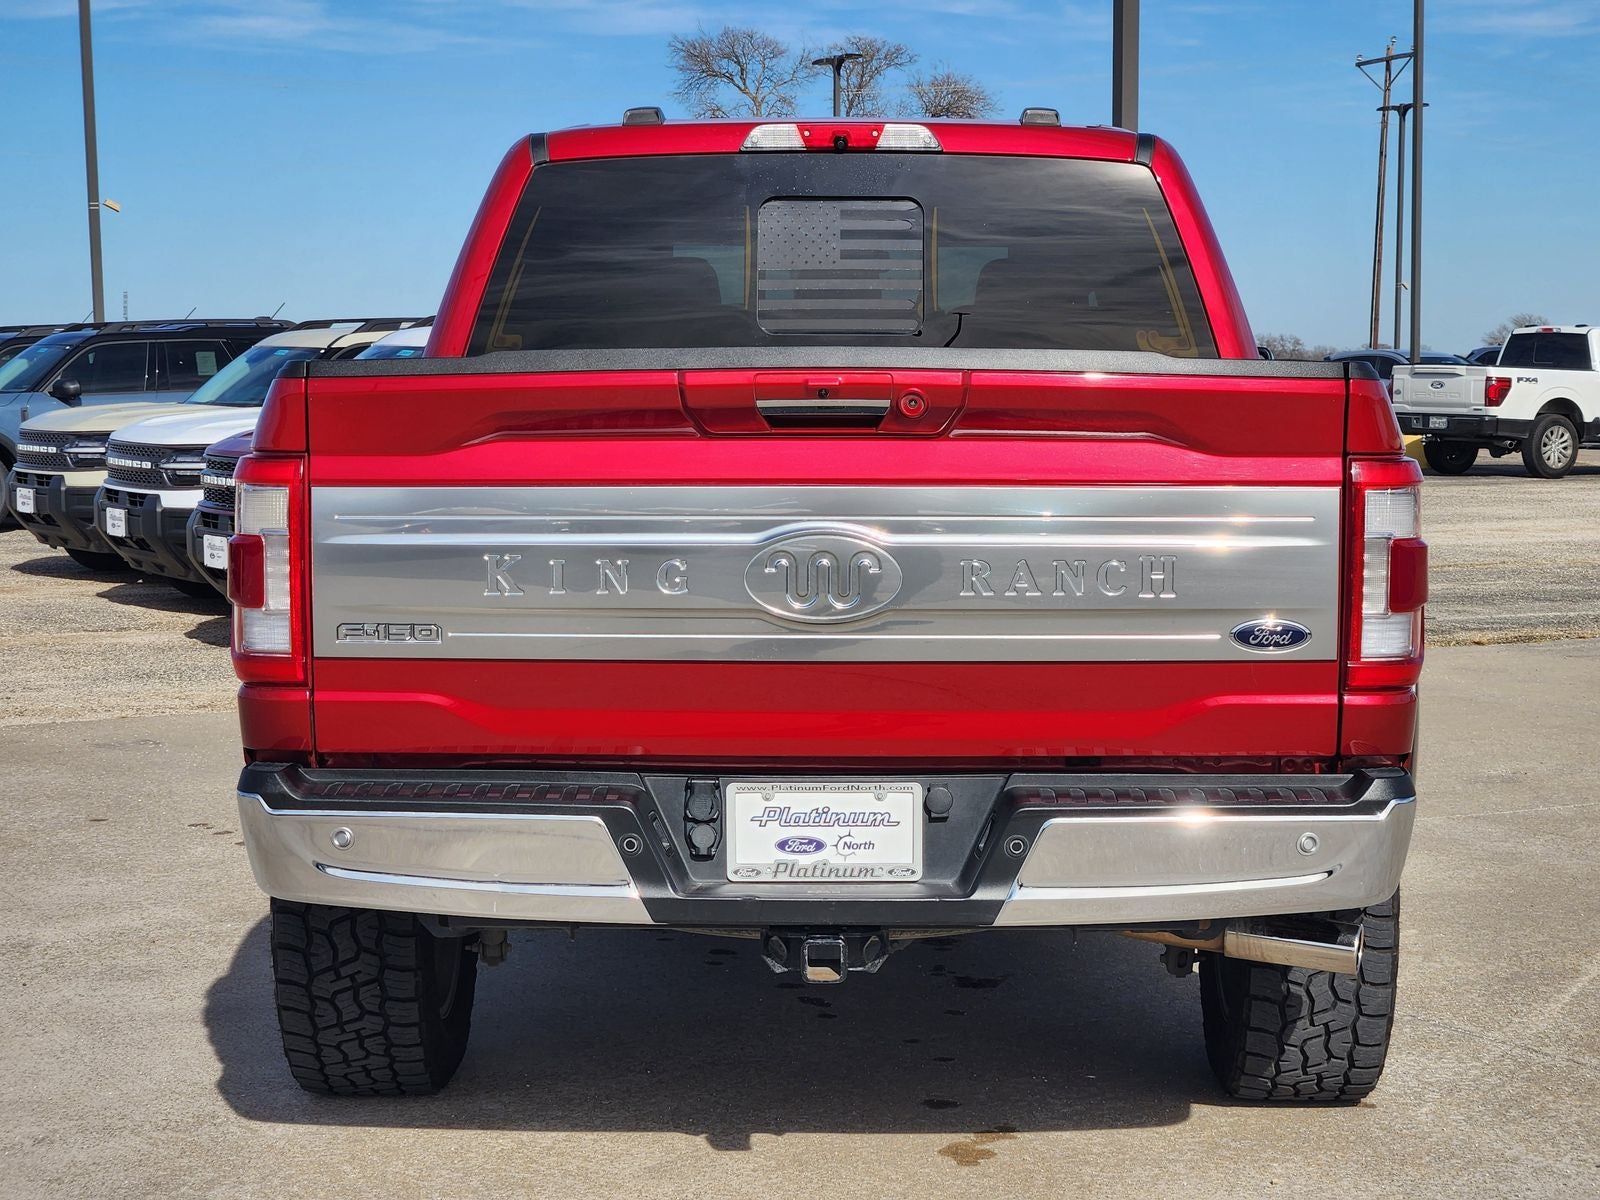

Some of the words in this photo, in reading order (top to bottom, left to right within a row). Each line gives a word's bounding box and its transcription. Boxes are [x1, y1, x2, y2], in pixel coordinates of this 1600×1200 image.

[1516, 376, 1539, 384] FX4
[203, 475, 236, 487] BRON
[483, 553, 690, 597] KING
[959, 554, 1178, 598] RANCH
[336, 623, 442, 644] F-150
[1249, 625, 1292, 645] Ford
[735, 784, 914, 792] www.PlatinumFordNorth.com
[750, 806, 901, 828] Platinum
[784, 839, 817, 853] Ford
[842, 840, 875, 851] North
[737, 868, 758, 878] Ford
[773, 861, 883, 878] Platinum
[892, 868, 912, 877] Ford
